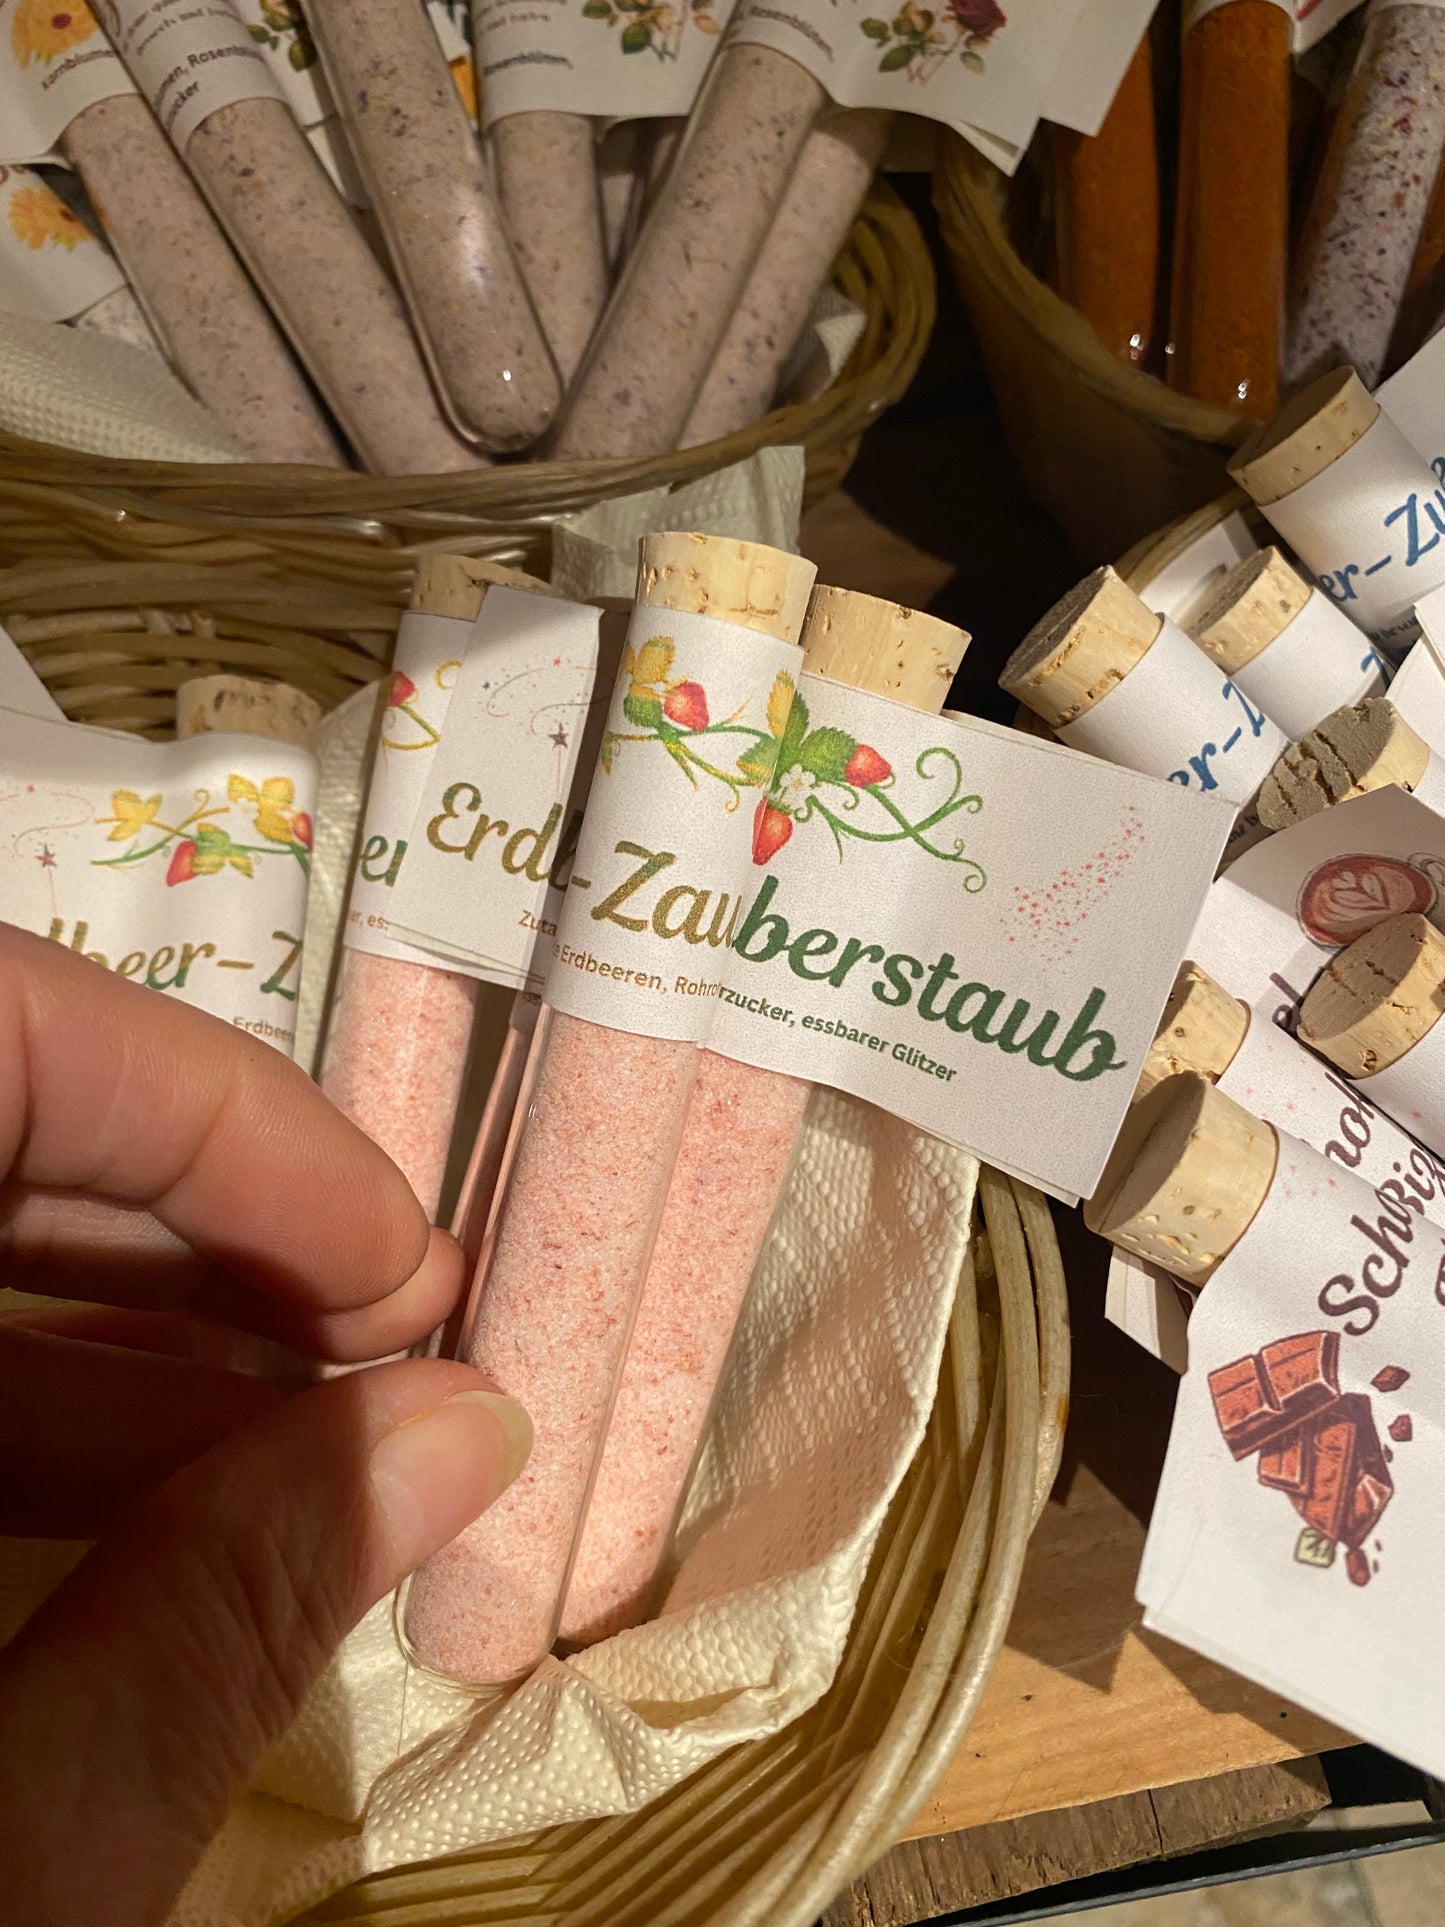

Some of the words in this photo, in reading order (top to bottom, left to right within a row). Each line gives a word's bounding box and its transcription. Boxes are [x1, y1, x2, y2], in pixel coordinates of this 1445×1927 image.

[560, 944, 668, 995] Erdbeeren,
[802, 1013, 890, 1054] essbarer
[892, 1042, 957, 1082] Glitzer
